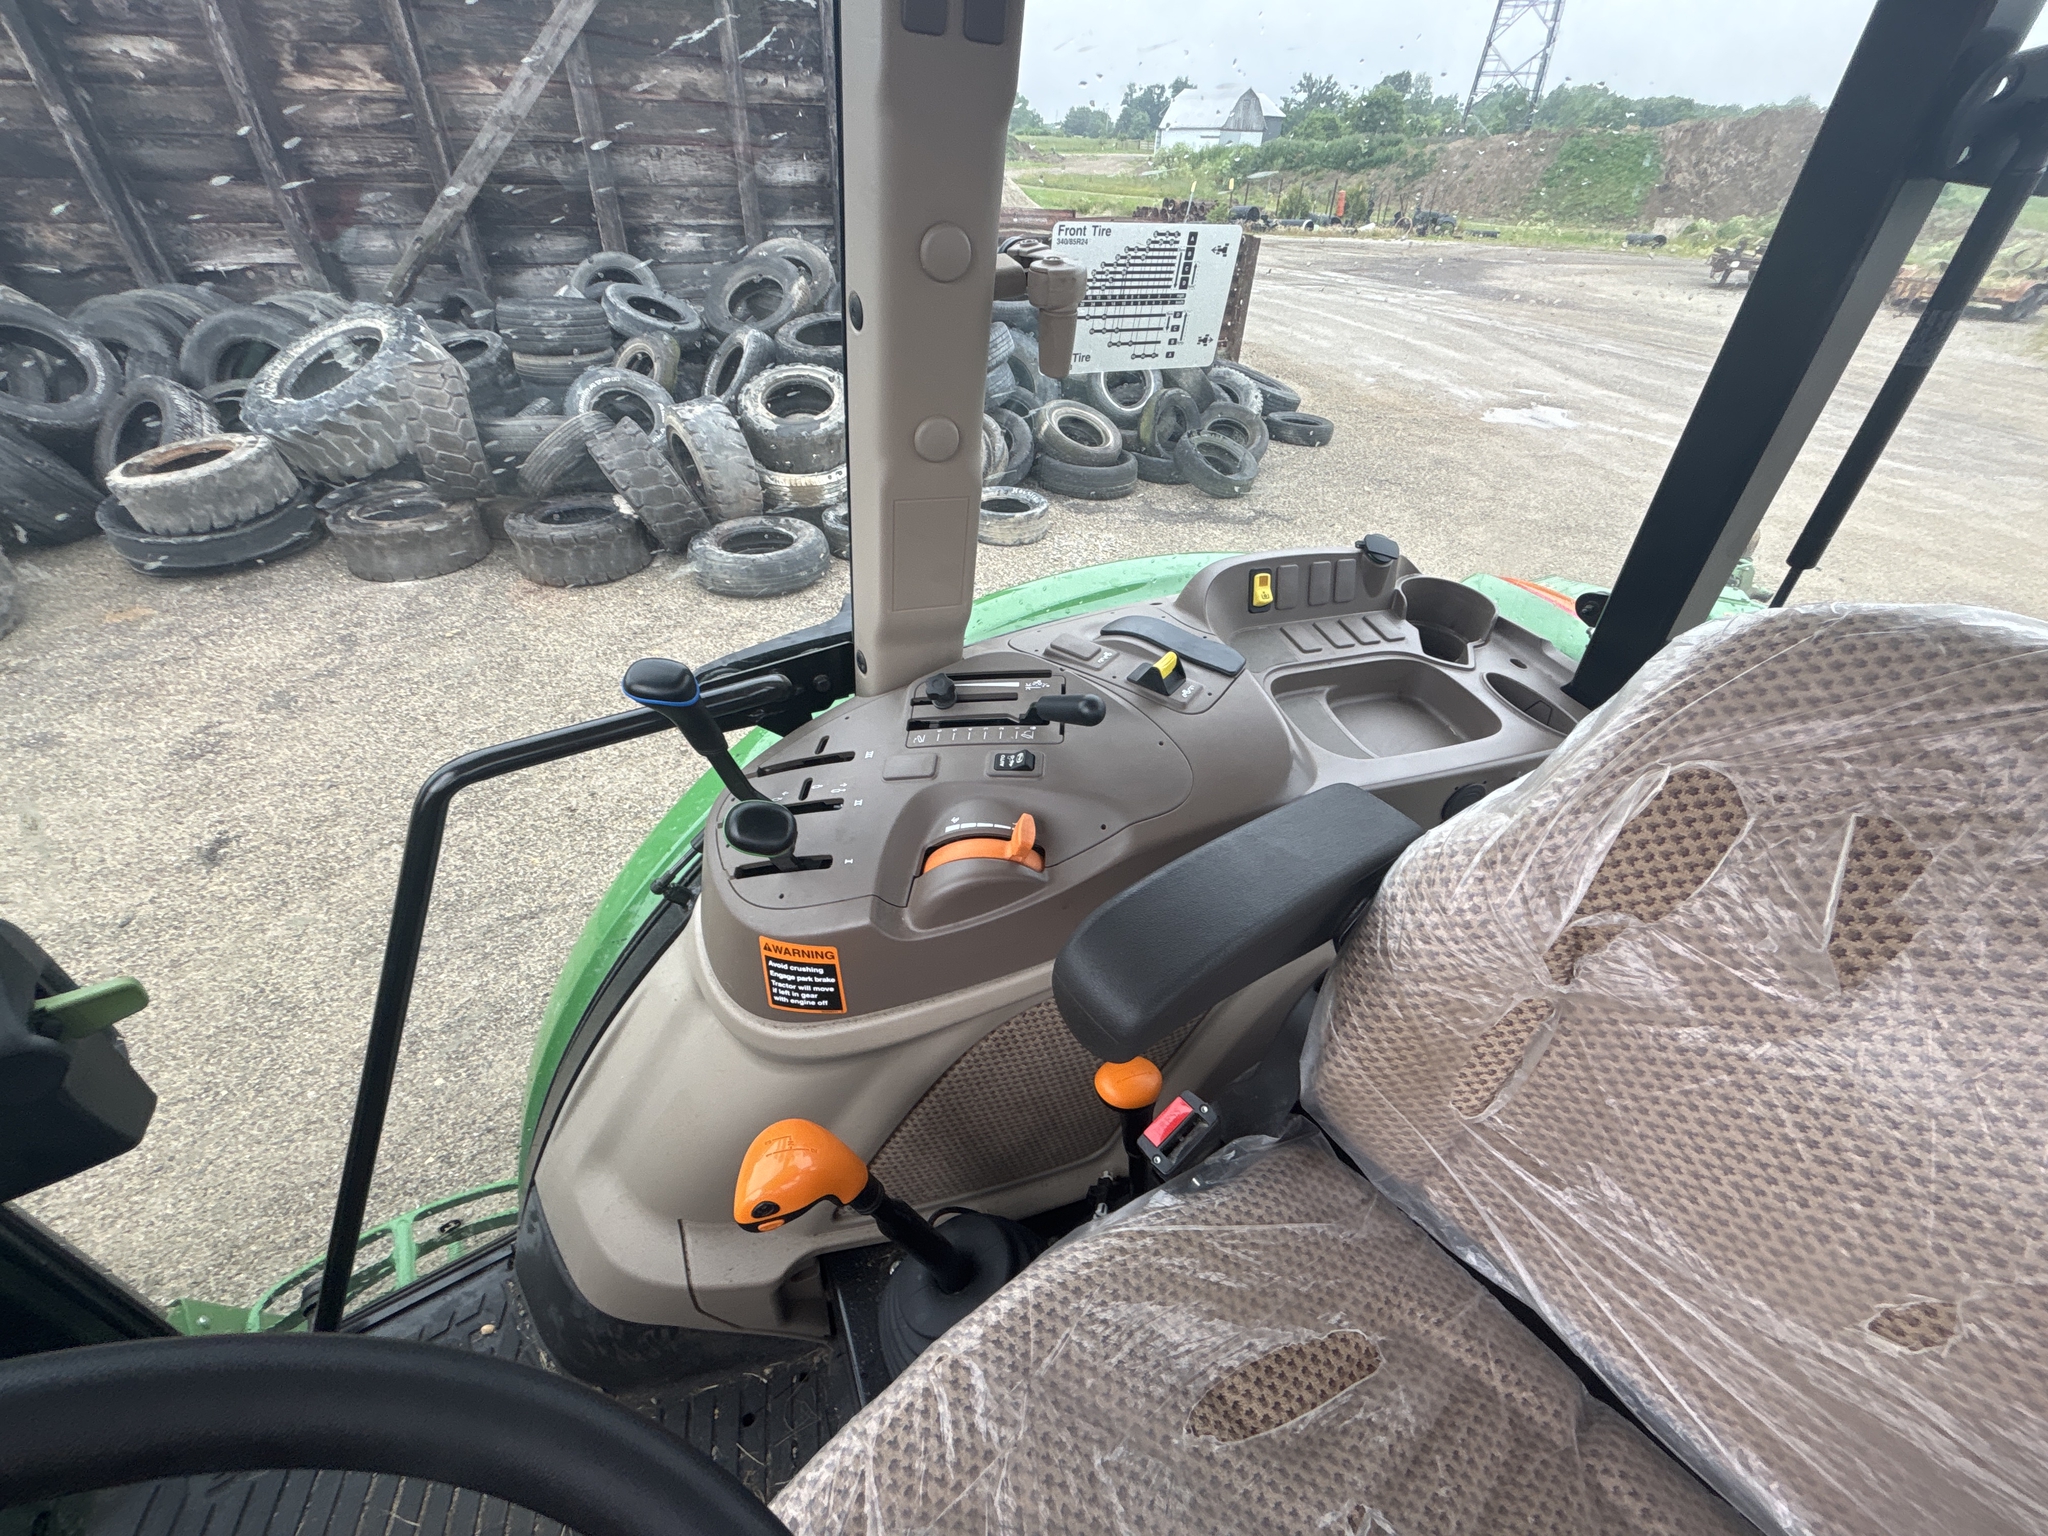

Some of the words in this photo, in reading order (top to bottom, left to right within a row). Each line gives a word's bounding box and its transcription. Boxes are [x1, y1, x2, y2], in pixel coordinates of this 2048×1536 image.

[1058, 224, 1087, 236] Front
[1092, 225, 1112, 237] Tire
[1056, 238, 1089, 246] 340/85R24
[1072, 353, 1091, 363] Tire
[771, 944, 836, 960] WARNING
[768, 960, 788, 970] Avoid
[789, 965, 825, 975] crushing
[769, 970, 796, 981] Engage
[796, 975, 814, 983] park
[770, 979, 797, 990] Tractor
[778, 988, 791, 997] left
[773, 995, 789, 1003] with
[789, 998, 816, 1006] engine
